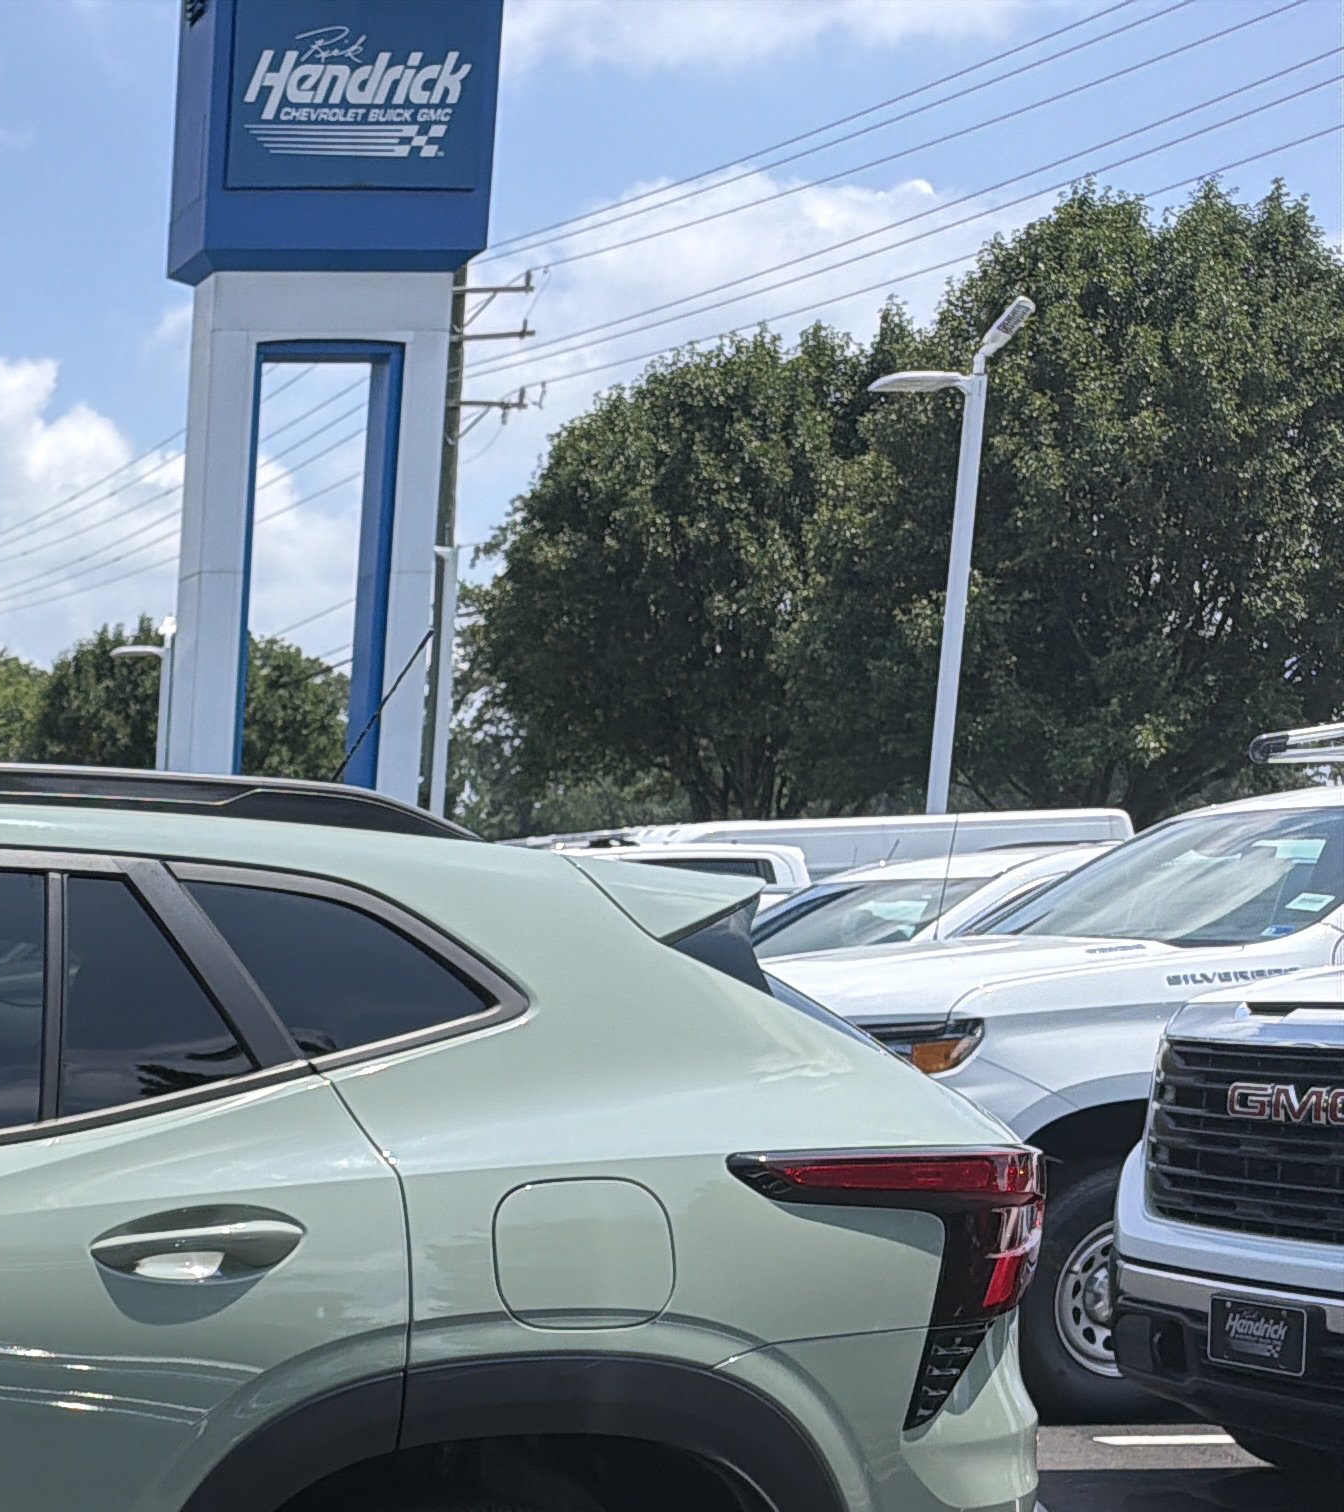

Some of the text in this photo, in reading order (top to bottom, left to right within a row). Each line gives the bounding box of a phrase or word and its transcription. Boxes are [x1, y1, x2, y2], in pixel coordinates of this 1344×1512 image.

[295, 25, 367, 63] Rick
[243, 50, 473, 120] Hendrick
[279, 107, 454, 122] CHEVROLET BUICK GMC
[1224, 1312, 1289, 1341] Hendrick
